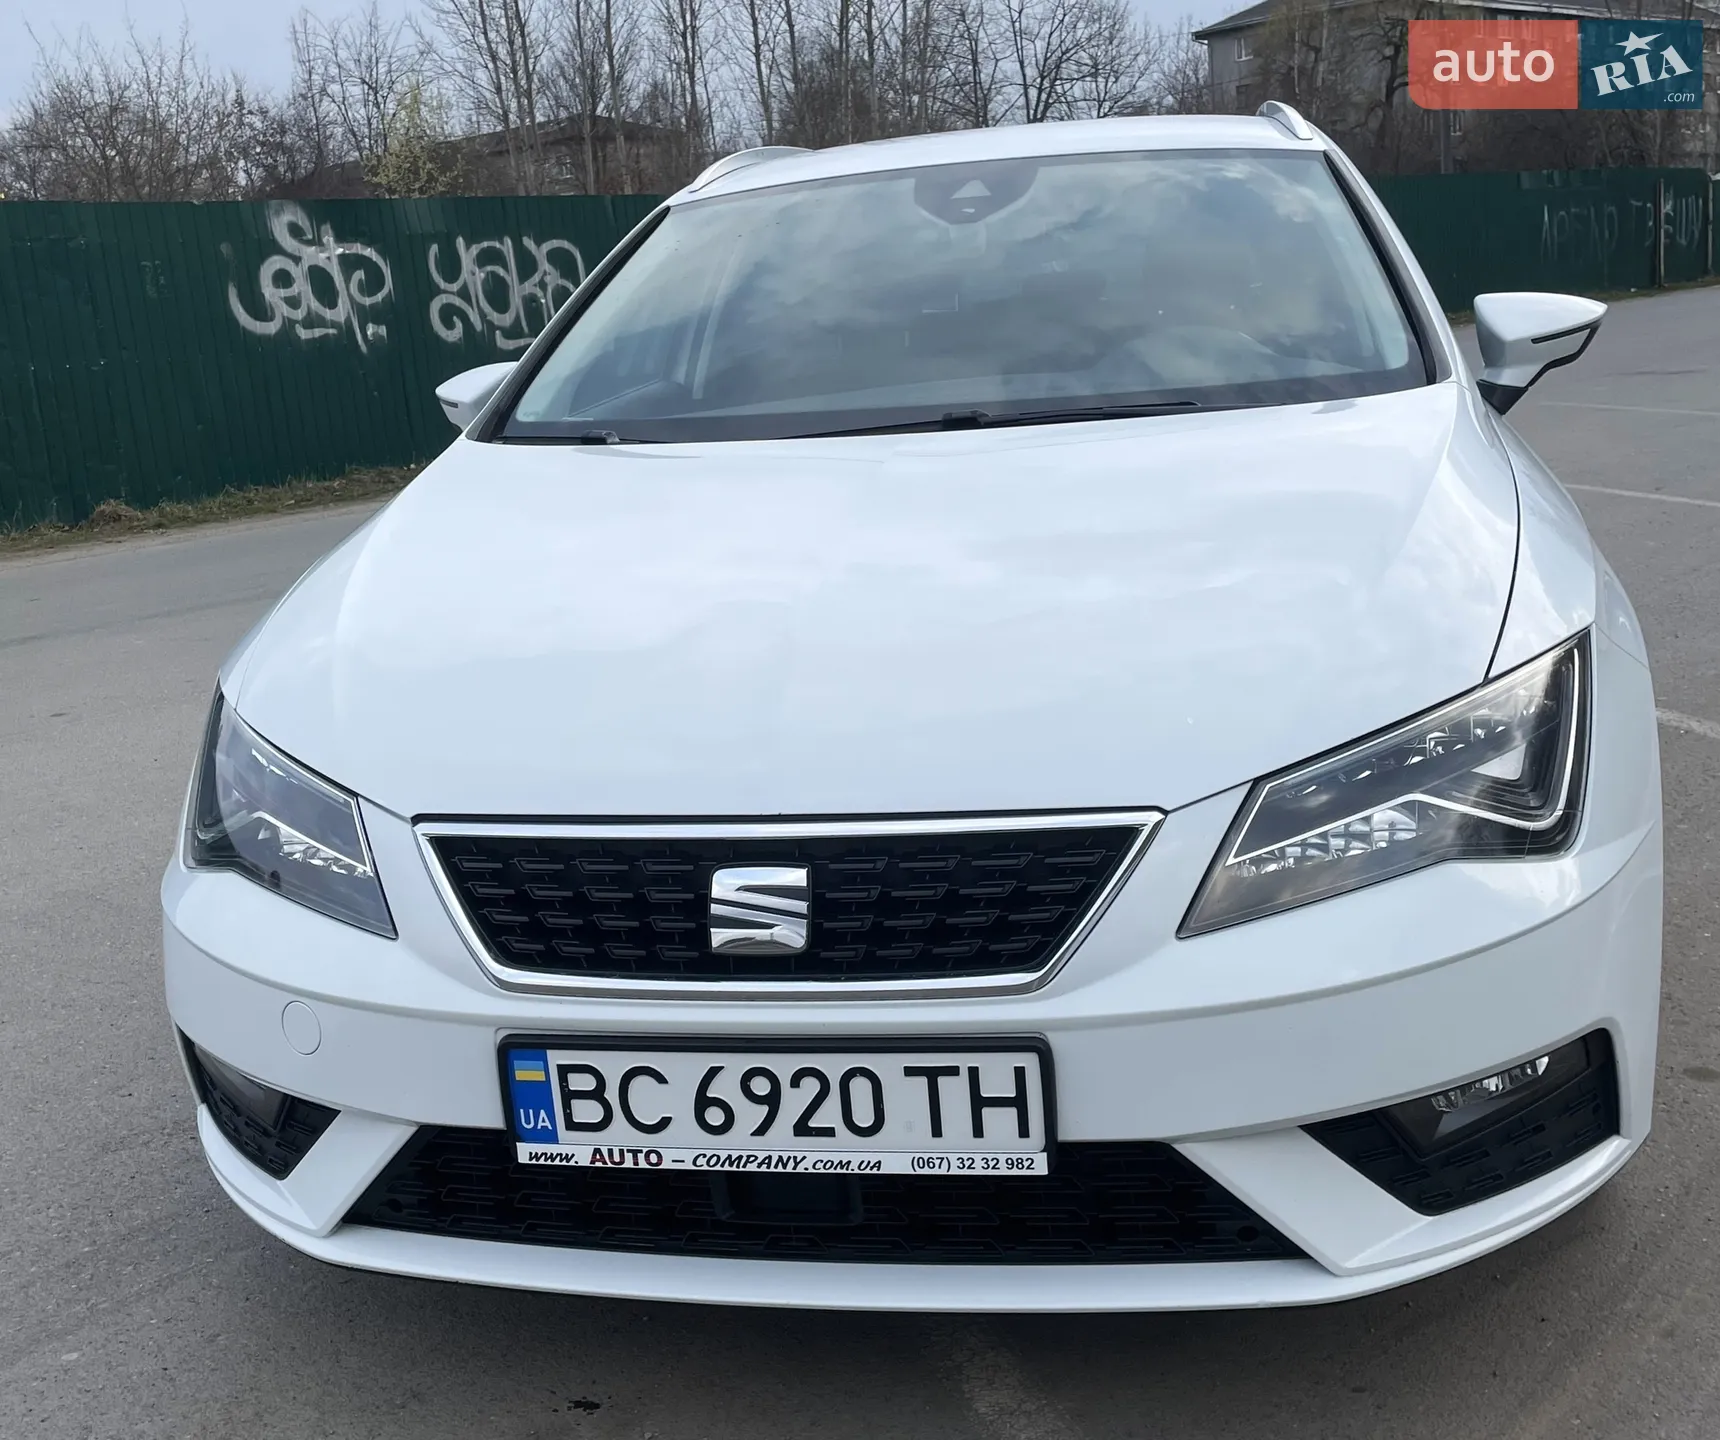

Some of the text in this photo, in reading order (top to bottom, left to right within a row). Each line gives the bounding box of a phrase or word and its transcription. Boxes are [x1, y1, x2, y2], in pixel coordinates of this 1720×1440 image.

[556, 1063, 1030, 1139] BC 6920 TH
[519, 1108, 553, 1130] UA
[528, 1151, 579, 1165] www.
[589, 1147, 664, 1168] AUTO
[910, 1156, 1035, 1172] (067) 32 32 982
